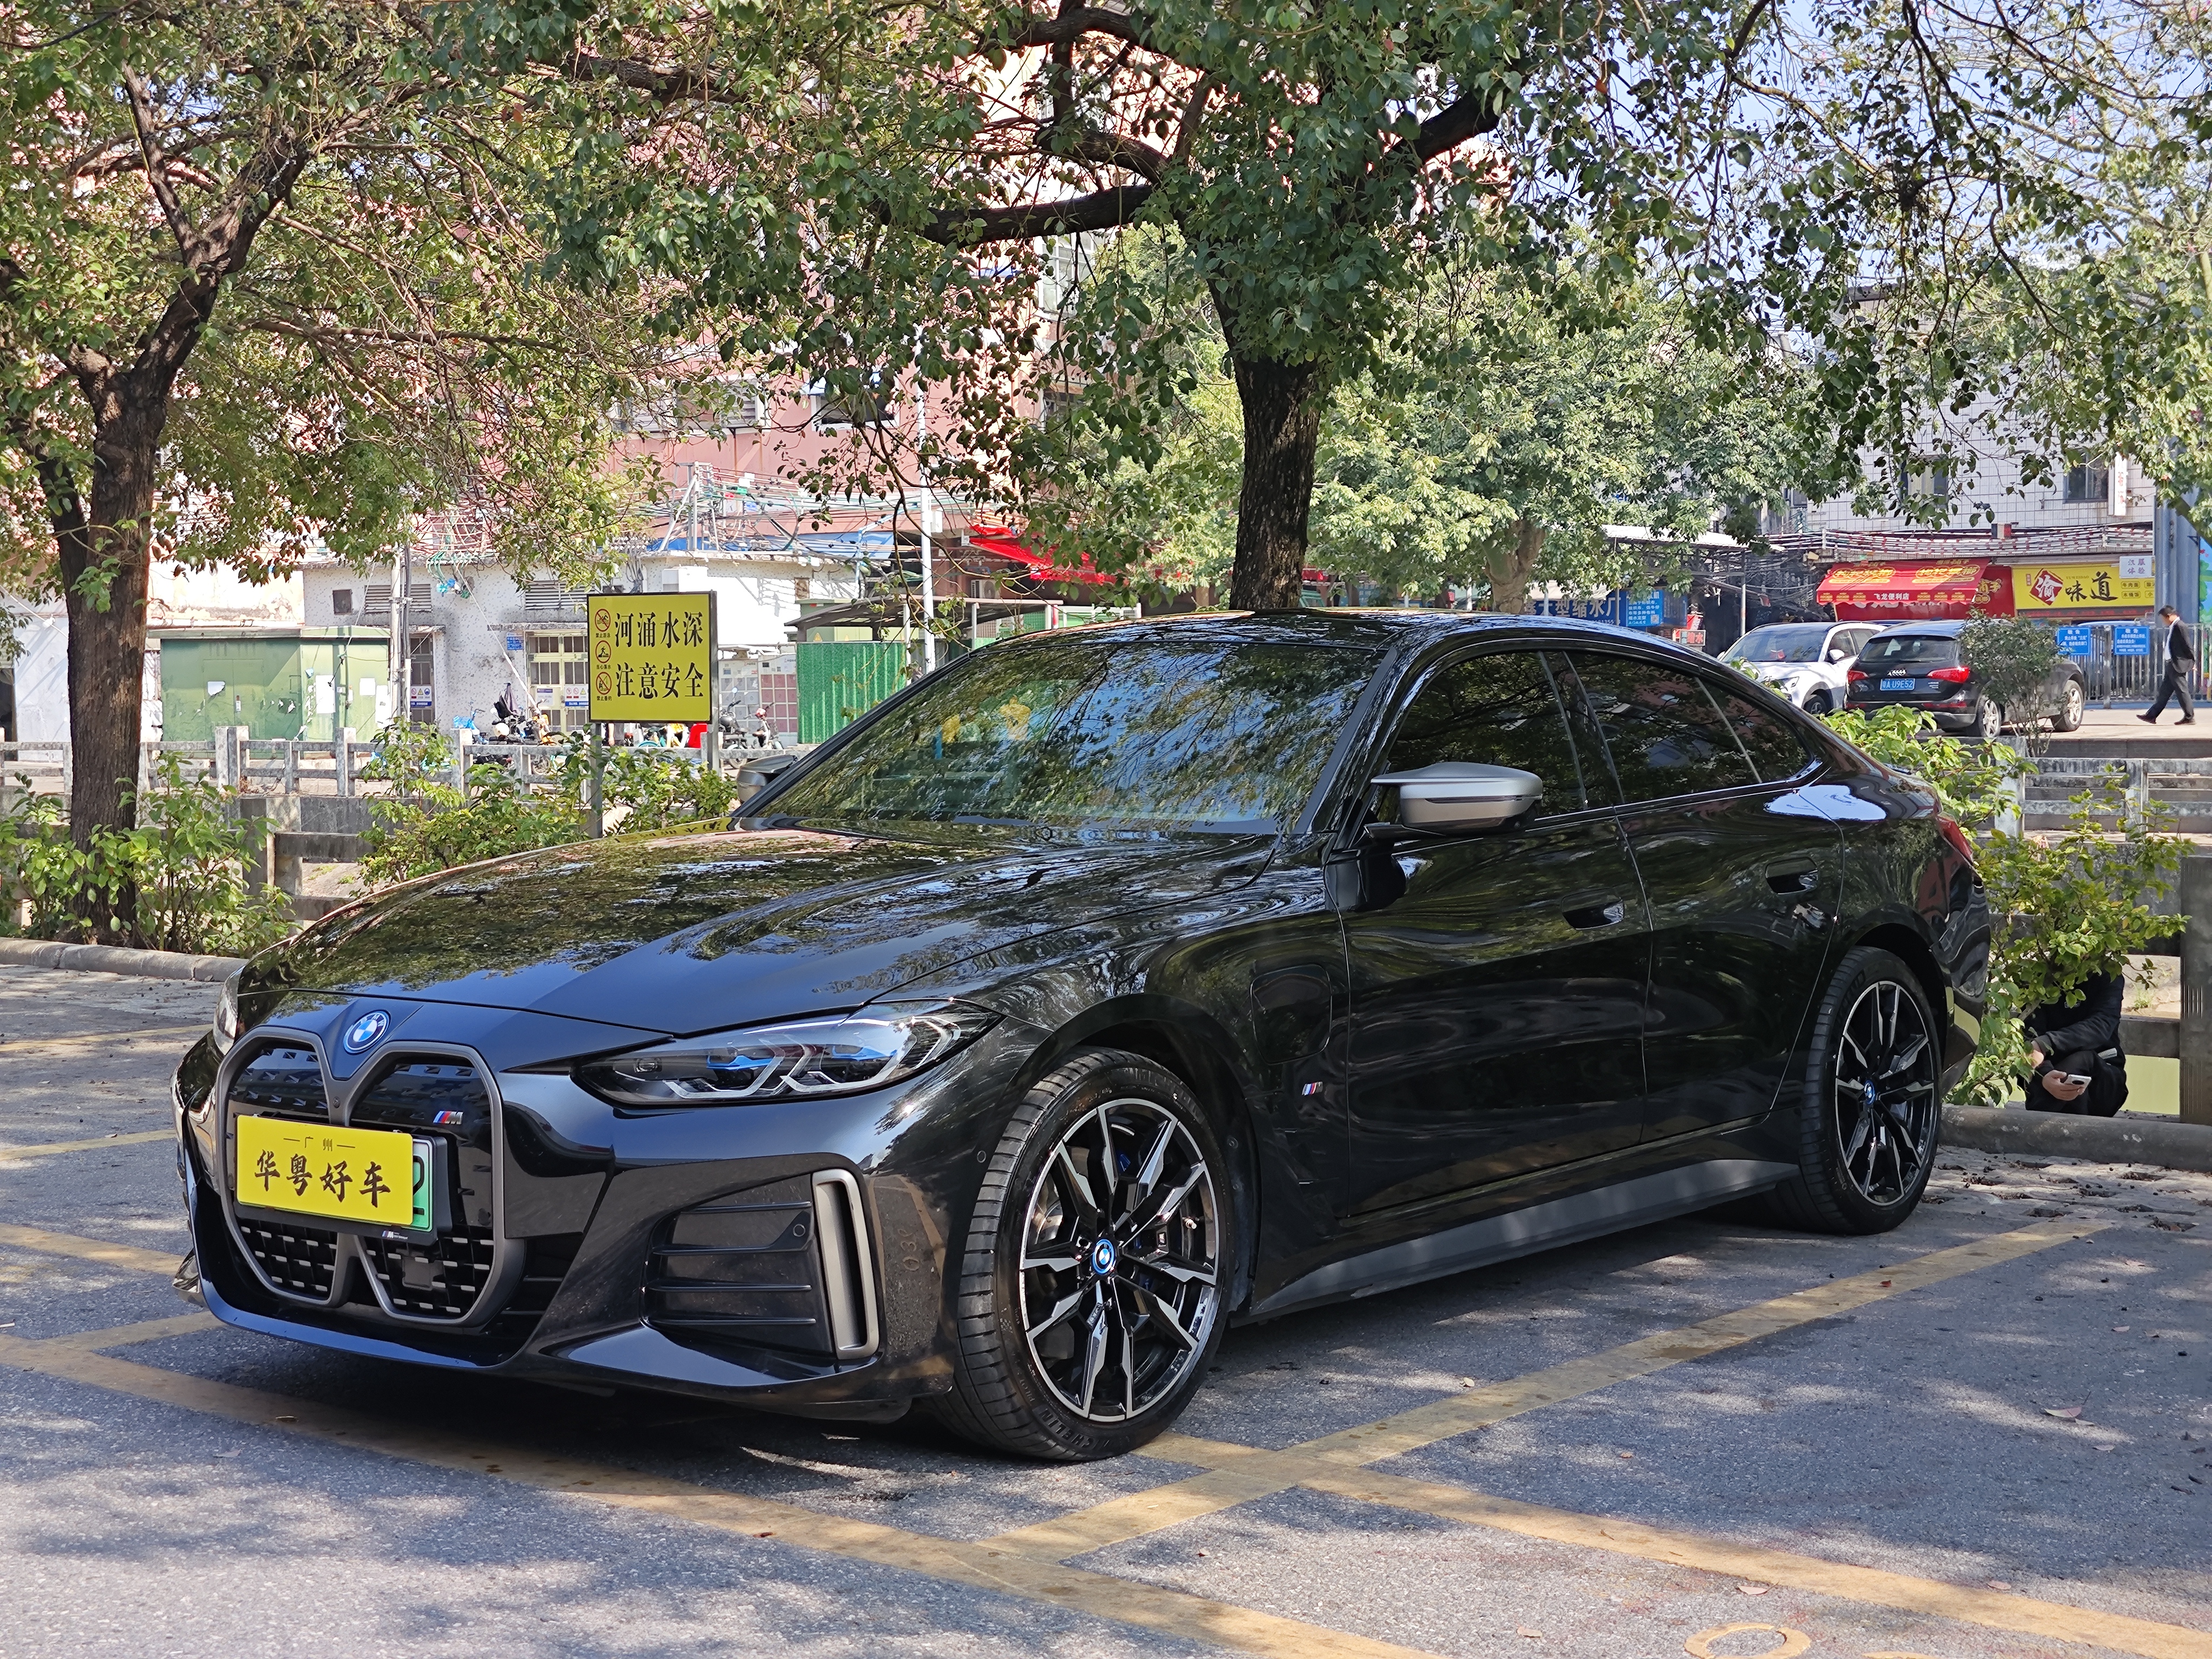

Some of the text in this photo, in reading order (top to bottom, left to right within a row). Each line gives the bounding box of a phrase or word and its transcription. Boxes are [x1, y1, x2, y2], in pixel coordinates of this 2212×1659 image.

[615, 611, 703, 648] 河涌水深
[616, 662, 704, 699] 注意安全
[304, 1136, 333, 1152] 广州
[254, 1149, 391, 1208] 华粤好车
